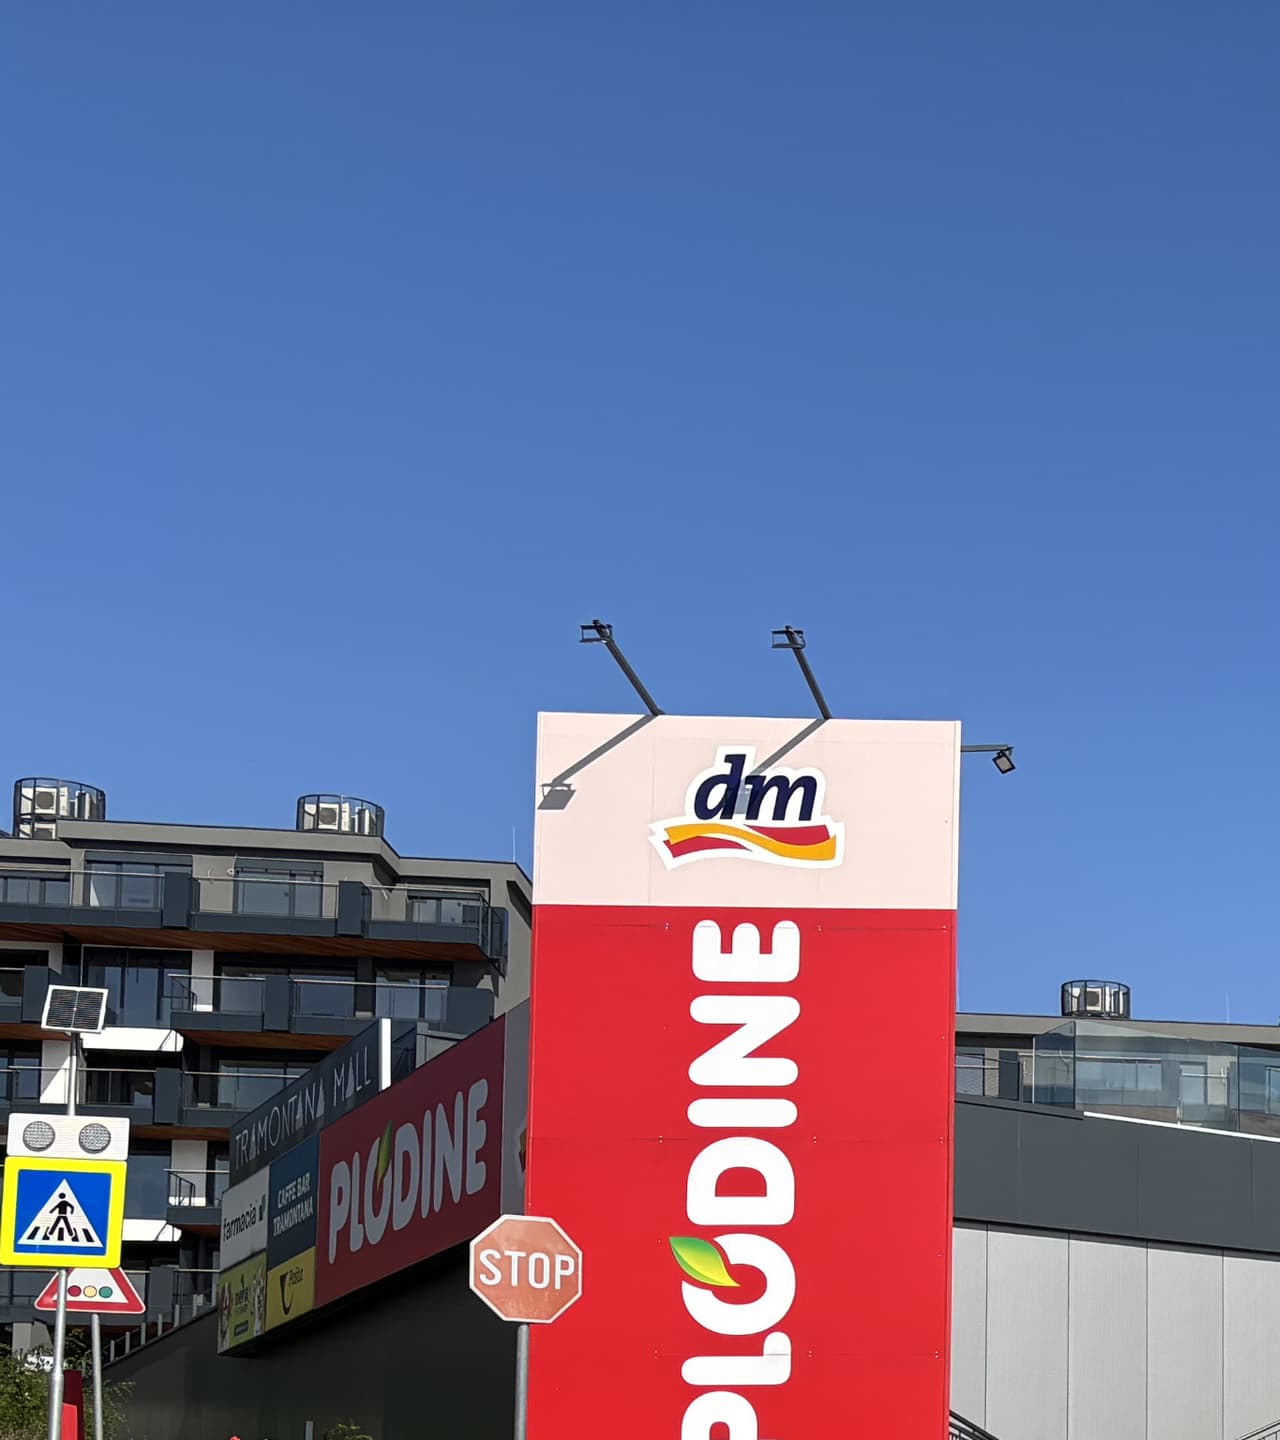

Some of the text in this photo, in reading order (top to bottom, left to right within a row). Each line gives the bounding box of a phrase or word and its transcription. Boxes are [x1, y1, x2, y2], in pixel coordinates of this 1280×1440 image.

[692, 753, 819, 822] dm
[234, 1044, 372, 1170] TRAMONTANA MALL
[277, 1172, 311, 1209] CAFFE BAR
[327, 1078, 489, 1265] PLODINE
[222, 1204, 257, 1242] farmacia
[272, 1197, 314, 1238] TRAMONTANA
[478, 1248, 576, 1290] STOP
